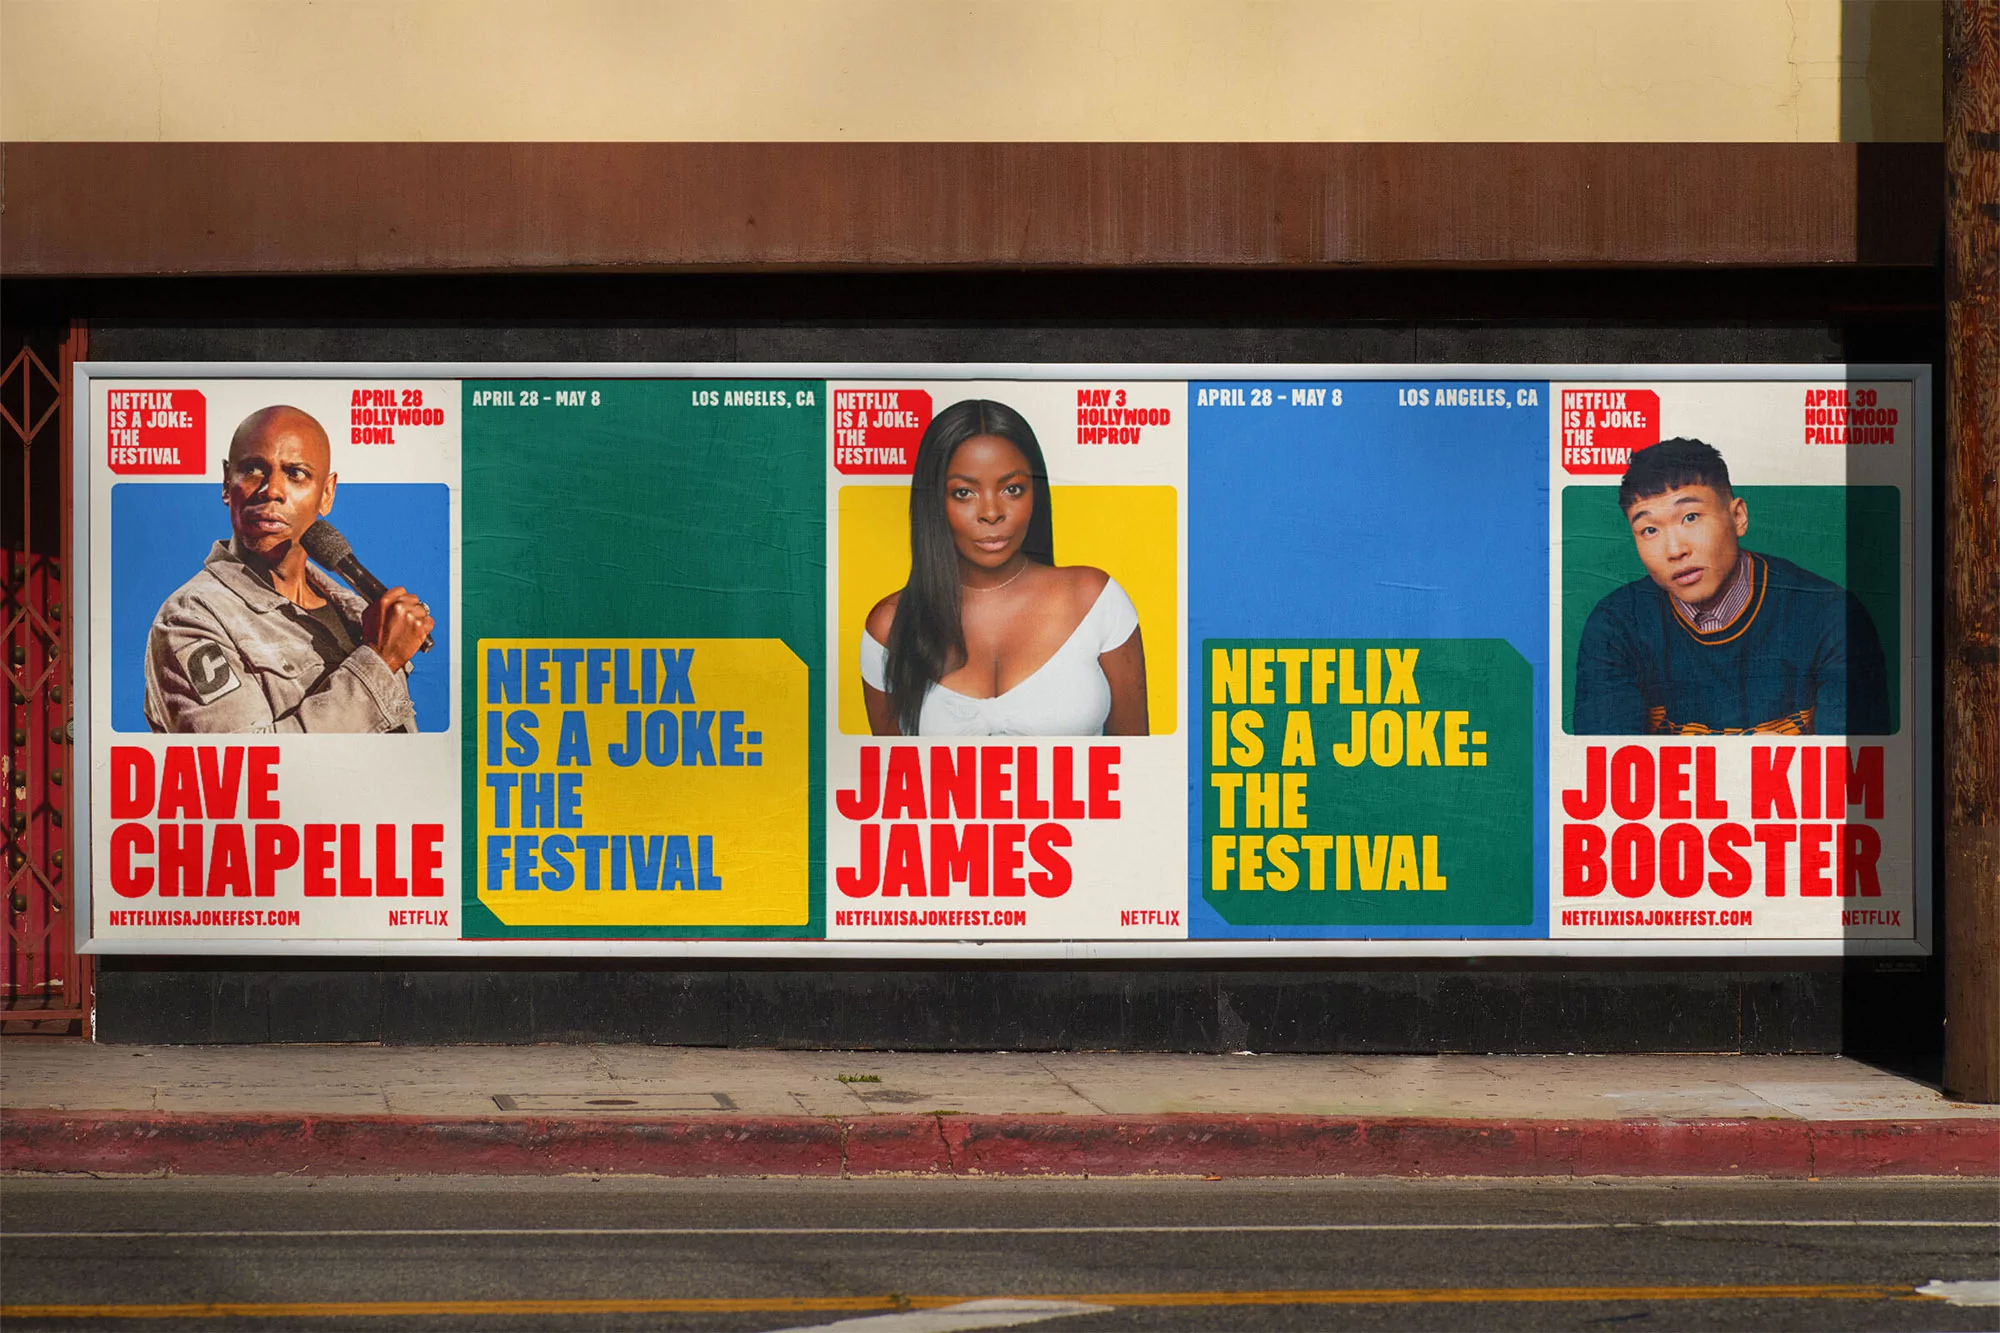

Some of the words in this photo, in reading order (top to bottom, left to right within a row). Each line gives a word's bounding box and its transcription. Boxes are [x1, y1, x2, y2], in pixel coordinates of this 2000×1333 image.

[111, 393, 172, 409] NETFLIX
[351, 390, 397, 406] APRIL
[402, 390, 422, 406] 28
[473, 391, 515, 406] APRIL
[520, 391, 539, 406] 28
[556, 391, 587, 406] MAY
[591, 391, 600, 406] 8
[692, 391, 719, 406] LOS
[724, 391, 791, 408] ANGELES,
[796, 391, 815, 406] CA
[837, 393, 898, 409] NETFLIX
[1078, 390, 1111, 406] MAY
[1116, 390, 1126, 406] 3
[1198, 389, 1245, 406] APRIL
[1251, 389, 1272, 406] 28
[1292, 389, 1326, 406] MAY
[1332, 389, 1342, 406] 8
[1399, 389, 1429, 406] LOS
[1435, 389, 1511, 409] ANGELES,
[1517, 389, 1538, 406] CA
[1565, 393, 1626, 409] NETFLIX
[1805, 390, 1850, 406] APRIL
[1856, 390, 1876, 406] 30
[111, 412, 128, 427] IS
[132, 412, 141, 427] A
[147, 412, 193, 427] JOKE:
[351, 409, 444, 425] HOLLYWOOD
[837, 412, 852, 428] IS
[858, 412, 868, 428] A
[873, 412, 918, 428] JOKE:
[1078, 409, 1170, 426] HOLLYWOOD
[1565, 411, 1580, 427] IS
[1585, 411, 1595, 427] A
[1601, 411, 1646, 428] JOKE:
[1805, 409, 1897, 425] HOLLYWOOD
[111, 430, 139, 446] THE
[351, 427, 394, 445] BOWL
[837, 430, 865, 446] THE
[1078, 428, 1140, 444] IMPROV
[1565, 430, 1593, 446] THE
[1805, 428, 1894, 444] PALLADIUM
[111, 448, 180, 465] FESTIVAL
[837, 448, 906, 465] FESTIVAL
[487, 649, 694, 704] NETFLIX
[1212, 649, 1420, 704] NETFLIX
[487, 710, 540, 767] IS
[556, 711, 591, 767] A
[608, 710, 762, 767] JOKE:
[1212, 710, 1264, 767] IS
[1281, 711, 1316, 767] A
[1333, 710, 1487, 767] JOKE:
[110, 746, 280, 819] DAVE
[836, 746, 1121, 820] JANELLE
[1562, 745, 1728, 820] JOEL
[1751, 746, 1884, 820] KIM
[487, 773, 582, 828] THE
[1212, 773, 1307, 828] THE
[110, 823, 444, 898] CHAPELLE
[487, 835, 721, 891] FESTIVAL
[836, 823, 1072, 898] JAMES
[1212, 835, 1446, 891] FESTIVAL
[1563, 823, 1881, 898] BOOSTER
[110, 911, 300, 926] NETFLIXISAJOKEFEST.COM
[389, 910, 448, 926] NETFLIX
[836, 911, 1026, 926] NETFLIXISAJOKEFEST.COM
[1121, 911, 1179, 926] NETFLIX
[1562, 911, 1752, 926] NETFLIXISAJOKEFEST.COM
[1842, 911, 1900, 926] NETFLIX
